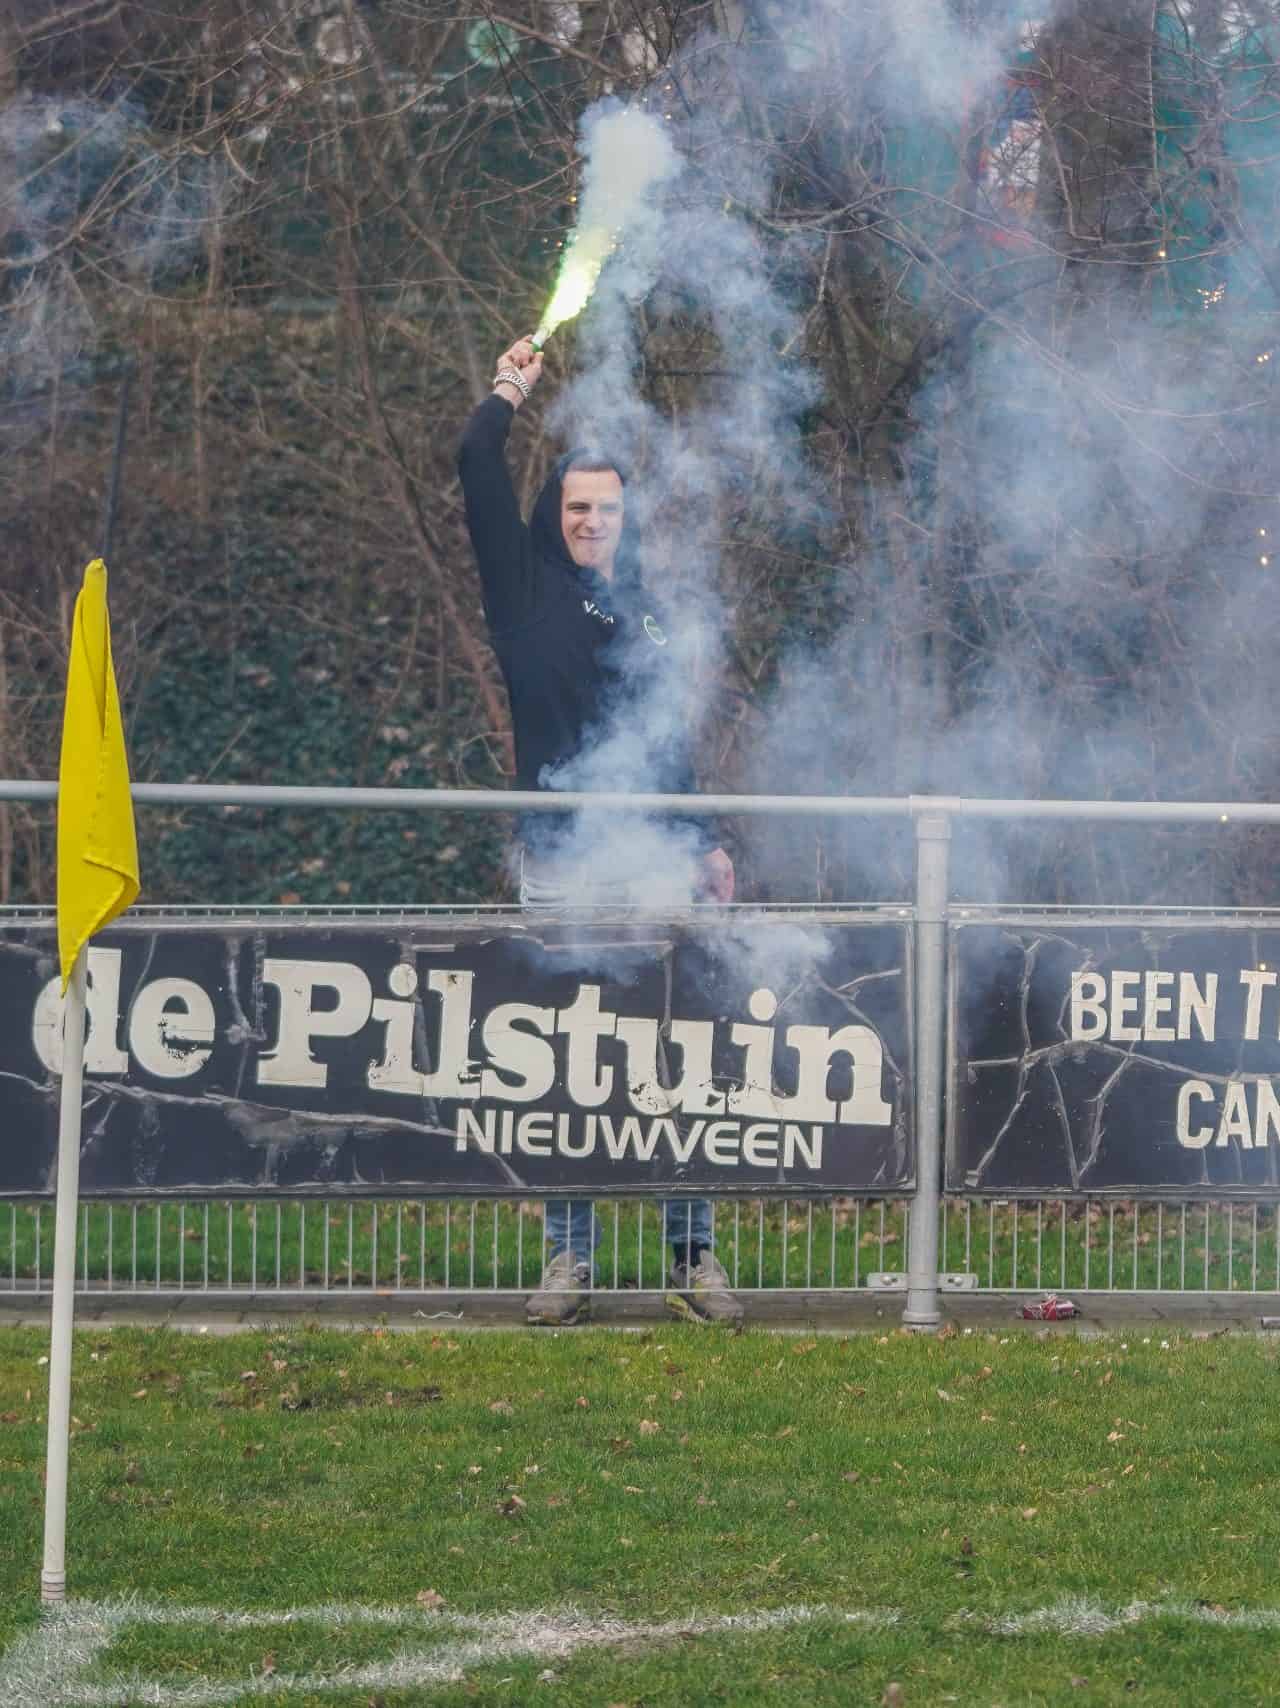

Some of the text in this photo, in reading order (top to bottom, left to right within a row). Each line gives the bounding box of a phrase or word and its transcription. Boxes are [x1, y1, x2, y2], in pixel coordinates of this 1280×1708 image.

[33, 947, 892, 1125] de Pilstuin
[1070, 971, 1218, 1042] BEEN
[455, 1108, 824, 1169] NIEUWVEEN
